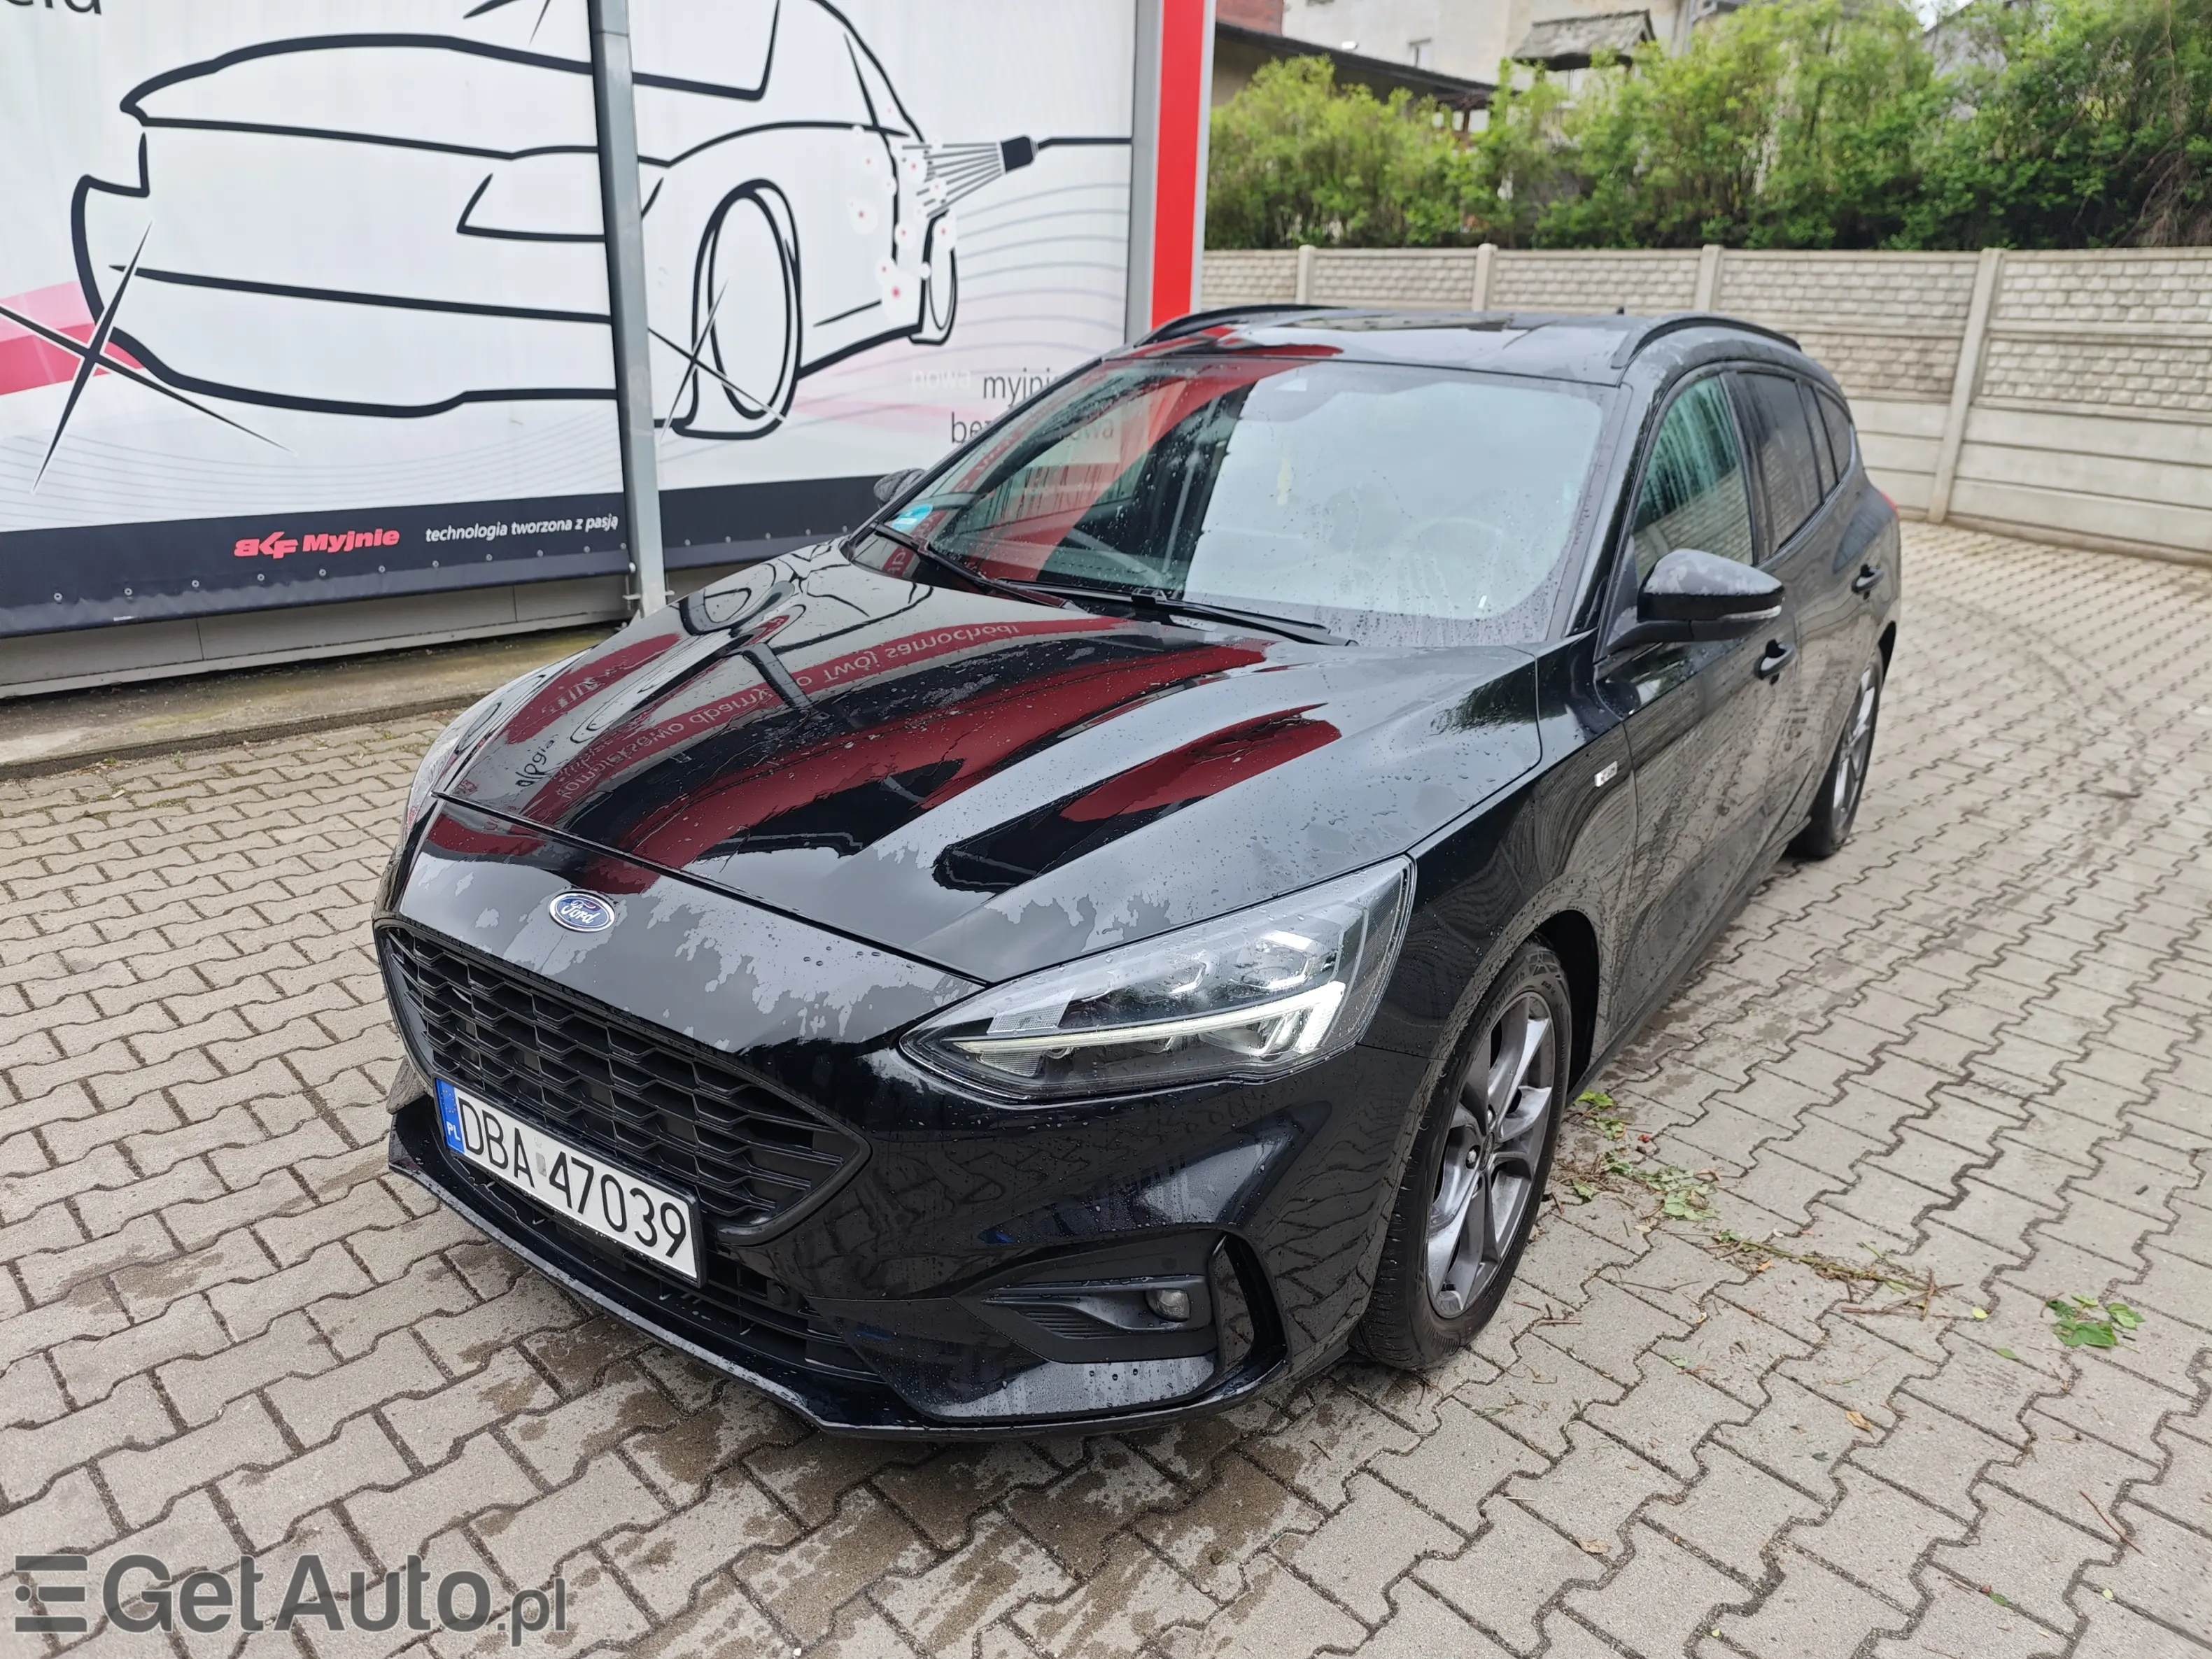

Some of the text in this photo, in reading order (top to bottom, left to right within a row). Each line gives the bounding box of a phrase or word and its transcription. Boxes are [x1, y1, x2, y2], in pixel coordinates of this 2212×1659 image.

[911, 367, 1057, 408] nowa myjni
[952, 411, 993, 444] be
[302, 528, 400, 553] Myjnie
[425, 513, 619, 542] technologia tworzona z pasją
[561, 900, 601, 924] Ford
[447, 1121, 461, 1141] PL
[458, 1096, 686, 1258] DBA 47039
